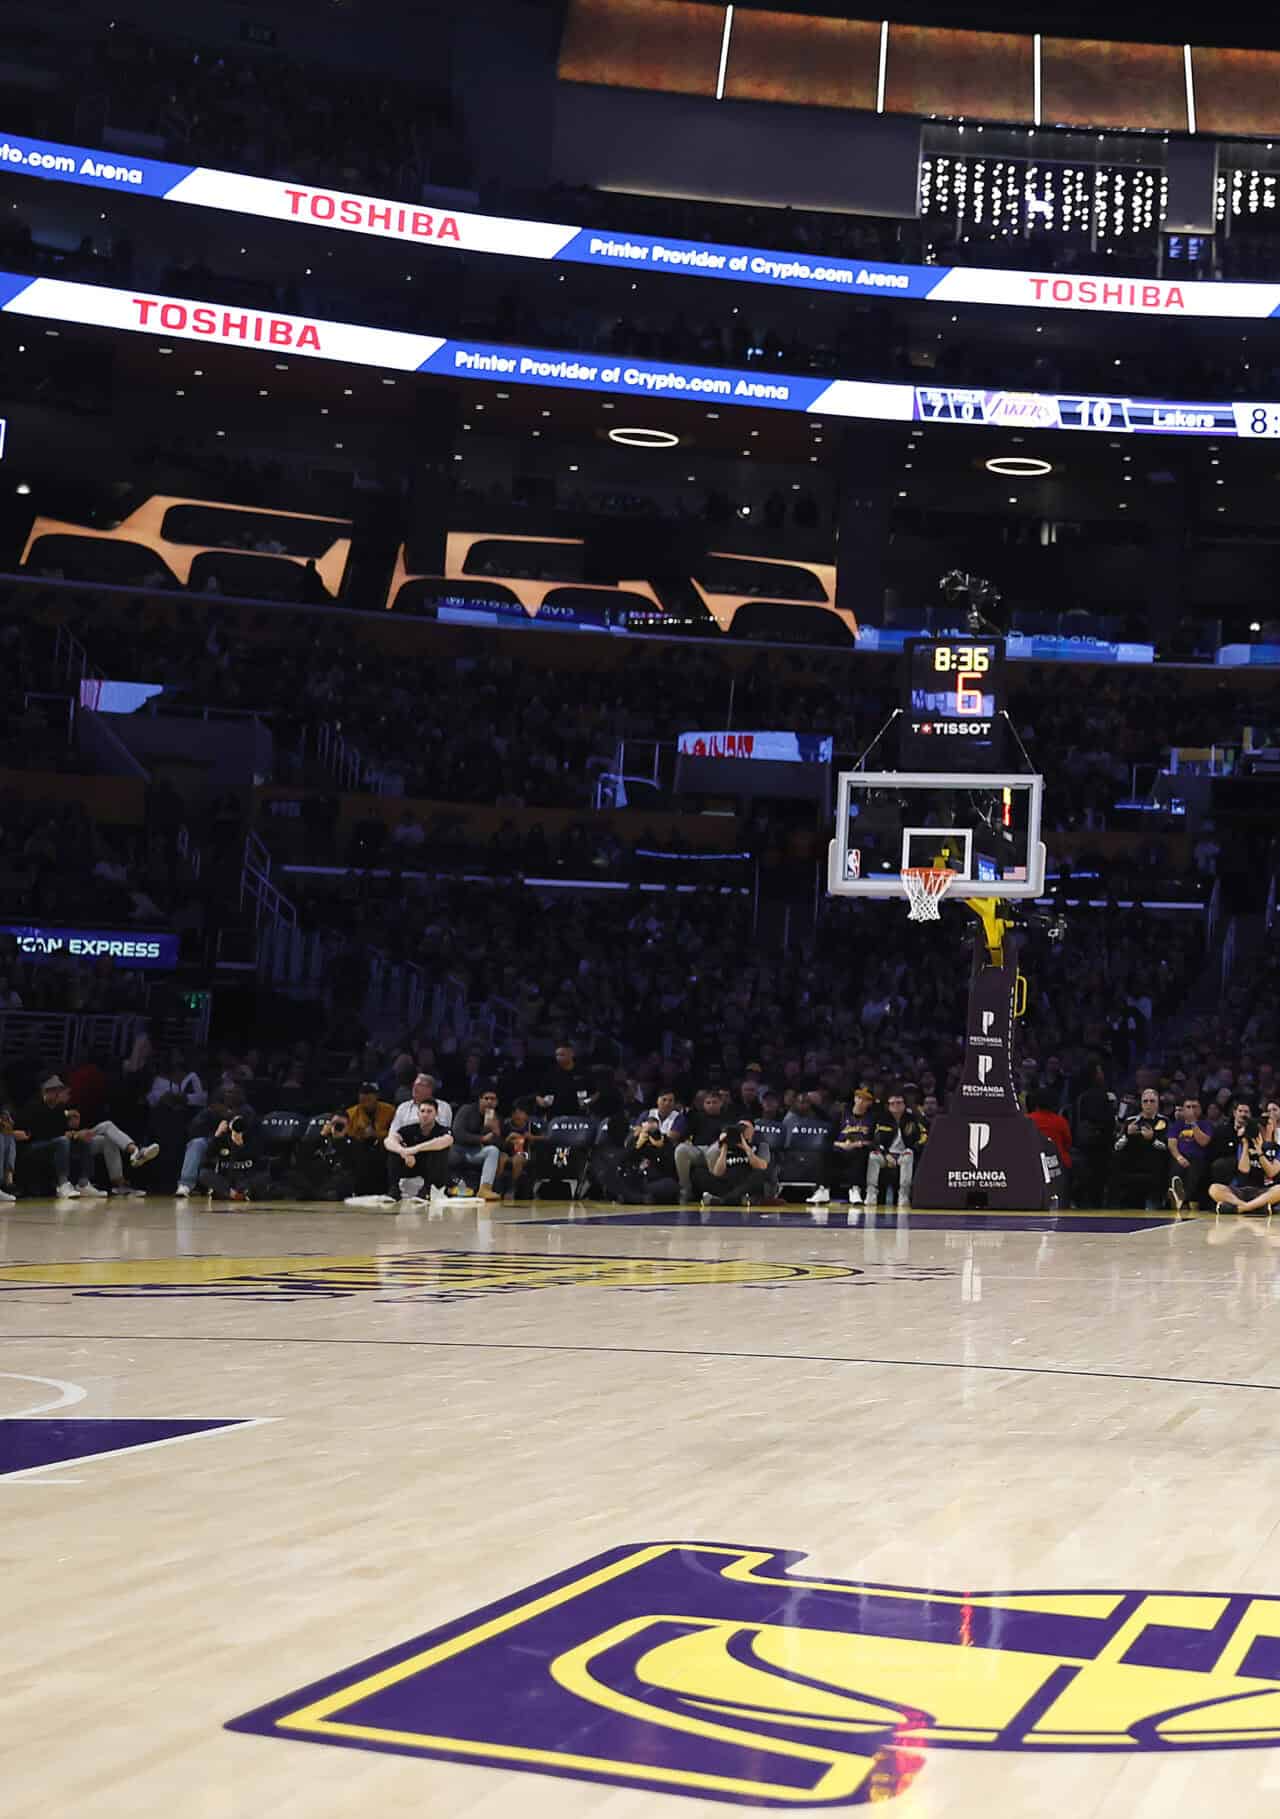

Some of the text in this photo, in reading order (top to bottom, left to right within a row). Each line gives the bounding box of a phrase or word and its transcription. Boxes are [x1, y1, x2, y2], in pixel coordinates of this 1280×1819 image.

[0, 143, 143, 184] to.com Arena
[284, 189, 462, 242] TOSHIBA
[590, 238, 909, 289] Printer Provider of Crypto.com Arena
[1029, 278, 1185, 309] TOSHIBA
[132, 298, 322, 351] TOSHIBA
[455, 350, 789, 401] Printer Provider of Crypto.com Arena
[1076, 402, 1112, 427] 10
[1153, 410, 1215, 428] Lakers
[934, 646, 990, 672] 8:36
[956, 671, 983, 715] 6
[933, 723, 992, 735] TISSOT
[17, 937, 161, 958] CAN EXPRESS
[962, 1084, 1005, 1093] PECHANGA
[948, 1171, 1007, 1181] PECHANGA
[948, 1180, 976, 1188] RESORT
